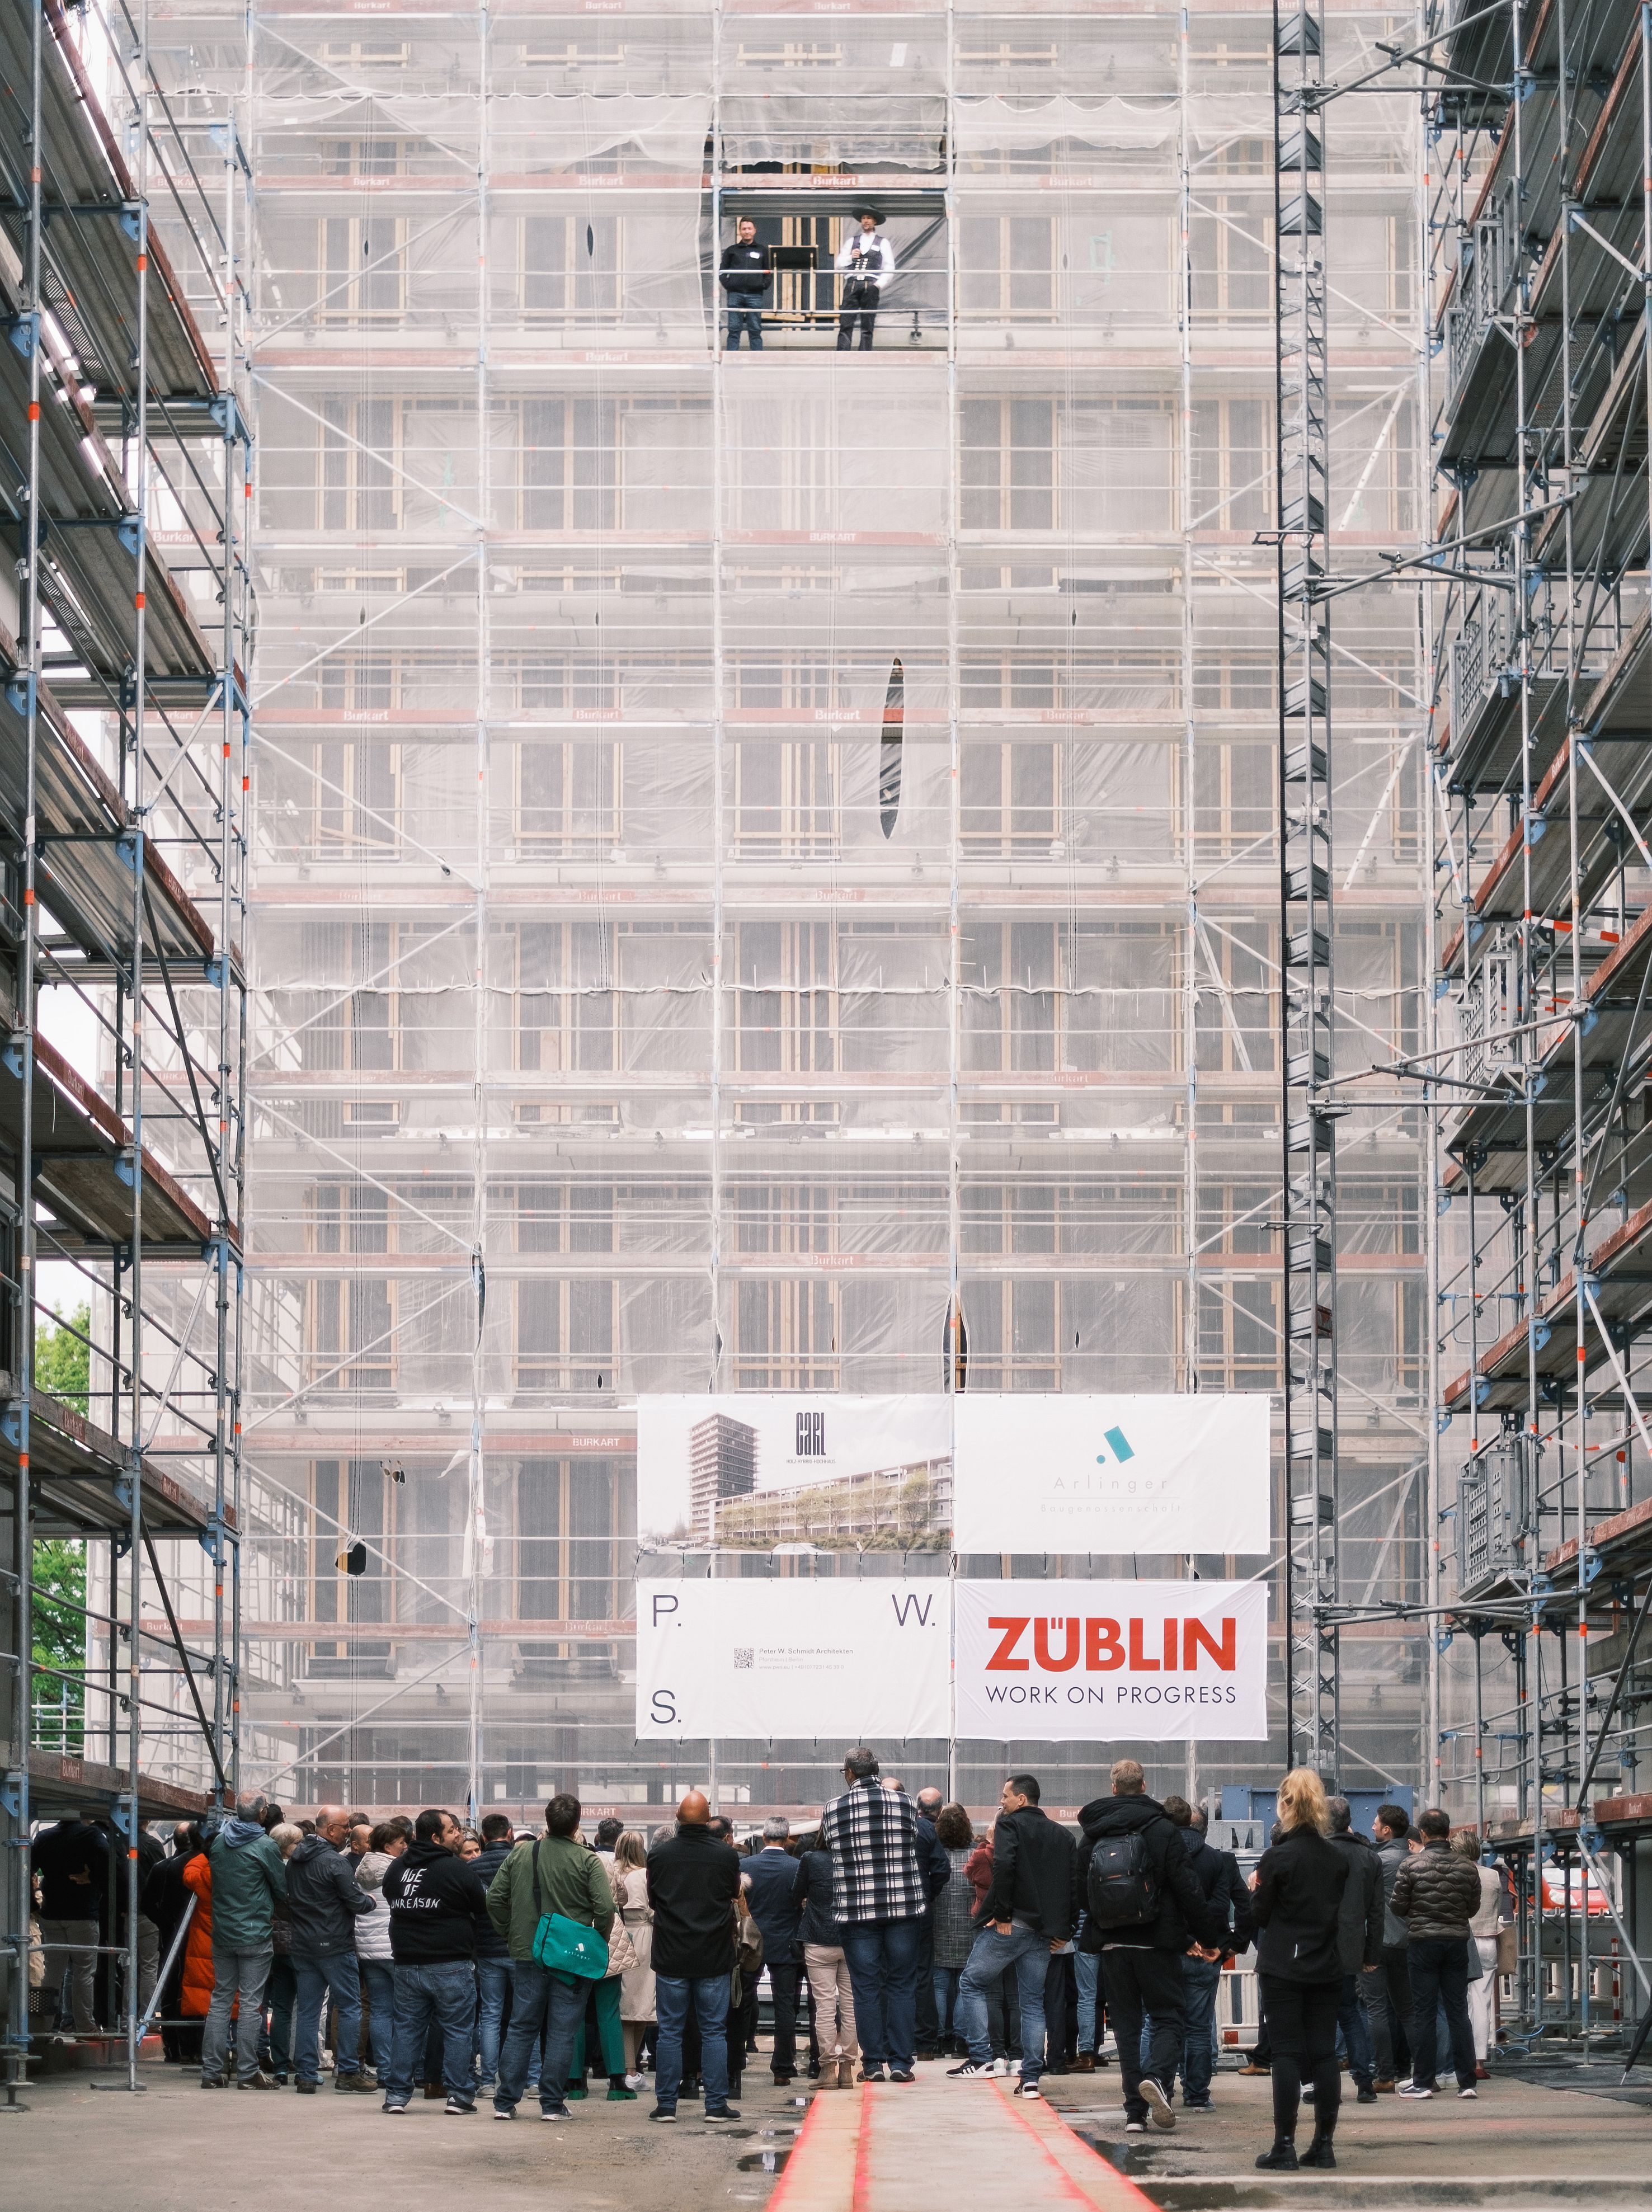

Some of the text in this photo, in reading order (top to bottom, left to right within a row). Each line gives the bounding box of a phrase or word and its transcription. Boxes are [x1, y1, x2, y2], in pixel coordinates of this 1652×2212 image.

[585, 1, 622, 10] Burkart
[353, 177, 390, 186] Burkart
[578, 175, 624, 186] Burkart
[813, 175, 856, 186] Burkart
[1049, 176, 1093, 186] Burkart
[585, 352, 629, 362] Burkart
[153, 531, 195, 543] Burkar
[809, 533, 856, 542] BURKART
[343, 709, 389, 721] Burkart
[576, 710, 619, 720] Burkart
[815, 709, 861, 720] Burkart
[578, 891, 621, 901] Burkart
[816, 890, 857, 901] Burkart
[811, 1255, 854, 1267] Burkart
[572, 1437, 620, 1448] BURKART
[1053, 1475, 1168, 1494] Arlinger
[1041, 1504, 1181, 1514] Baugenossenschaft
[653, 1594, 681, 1627] P.
[892, 1594, 936, 1627] W.
[985, 1617, 1236, 1672] ZÜBLIN
[986, 1686, 1236, 1704] WORK ON PROGRESS
[650, 1689, 682, 1725] S.
[400, 1867, 427, 1882] AGE
[403, 1884, 420, 1896] OF
[391, 1897, 441, 1909] UNREASON
